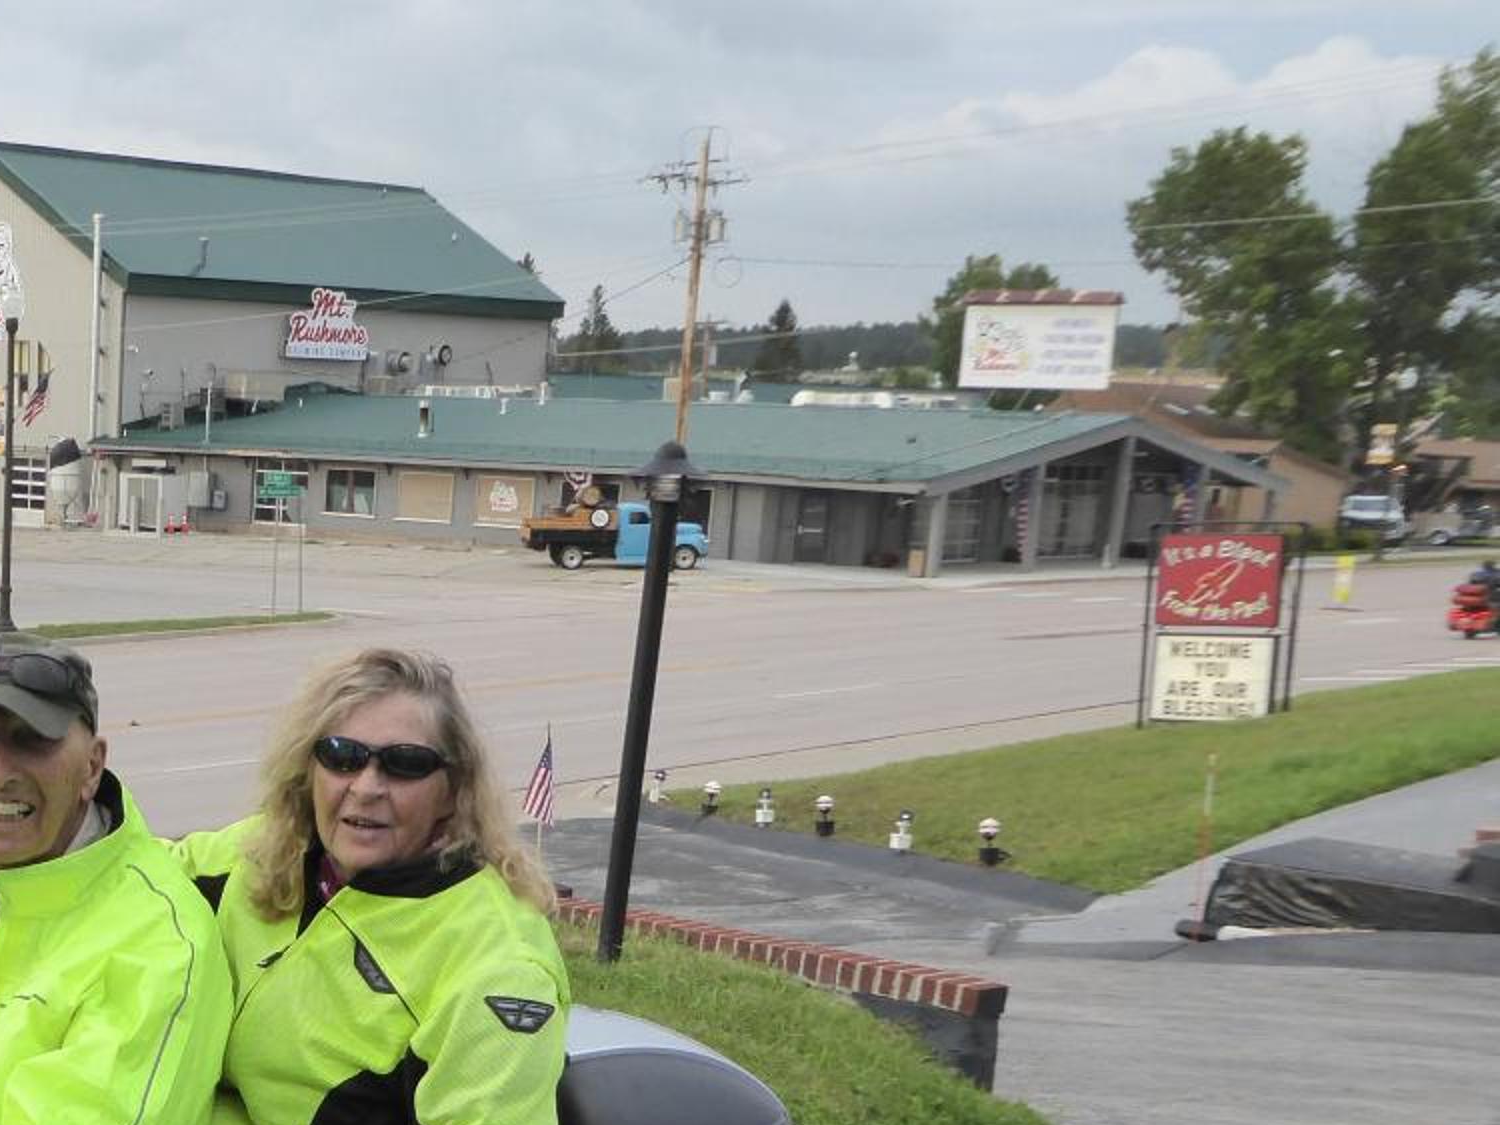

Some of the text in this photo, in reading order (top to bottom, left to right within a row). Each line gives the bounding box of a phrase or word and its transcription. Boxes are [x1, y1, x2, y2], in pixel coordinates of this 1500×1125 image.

[311, 289, 357, 320] Mt.
[291, 315, 366, 345] Rushmore
[1169, 641, 1252, 659] WELCOME
[1194, 661, 1229, 679] YOU
[1165, 680, 1248, 699] ARE OUR
